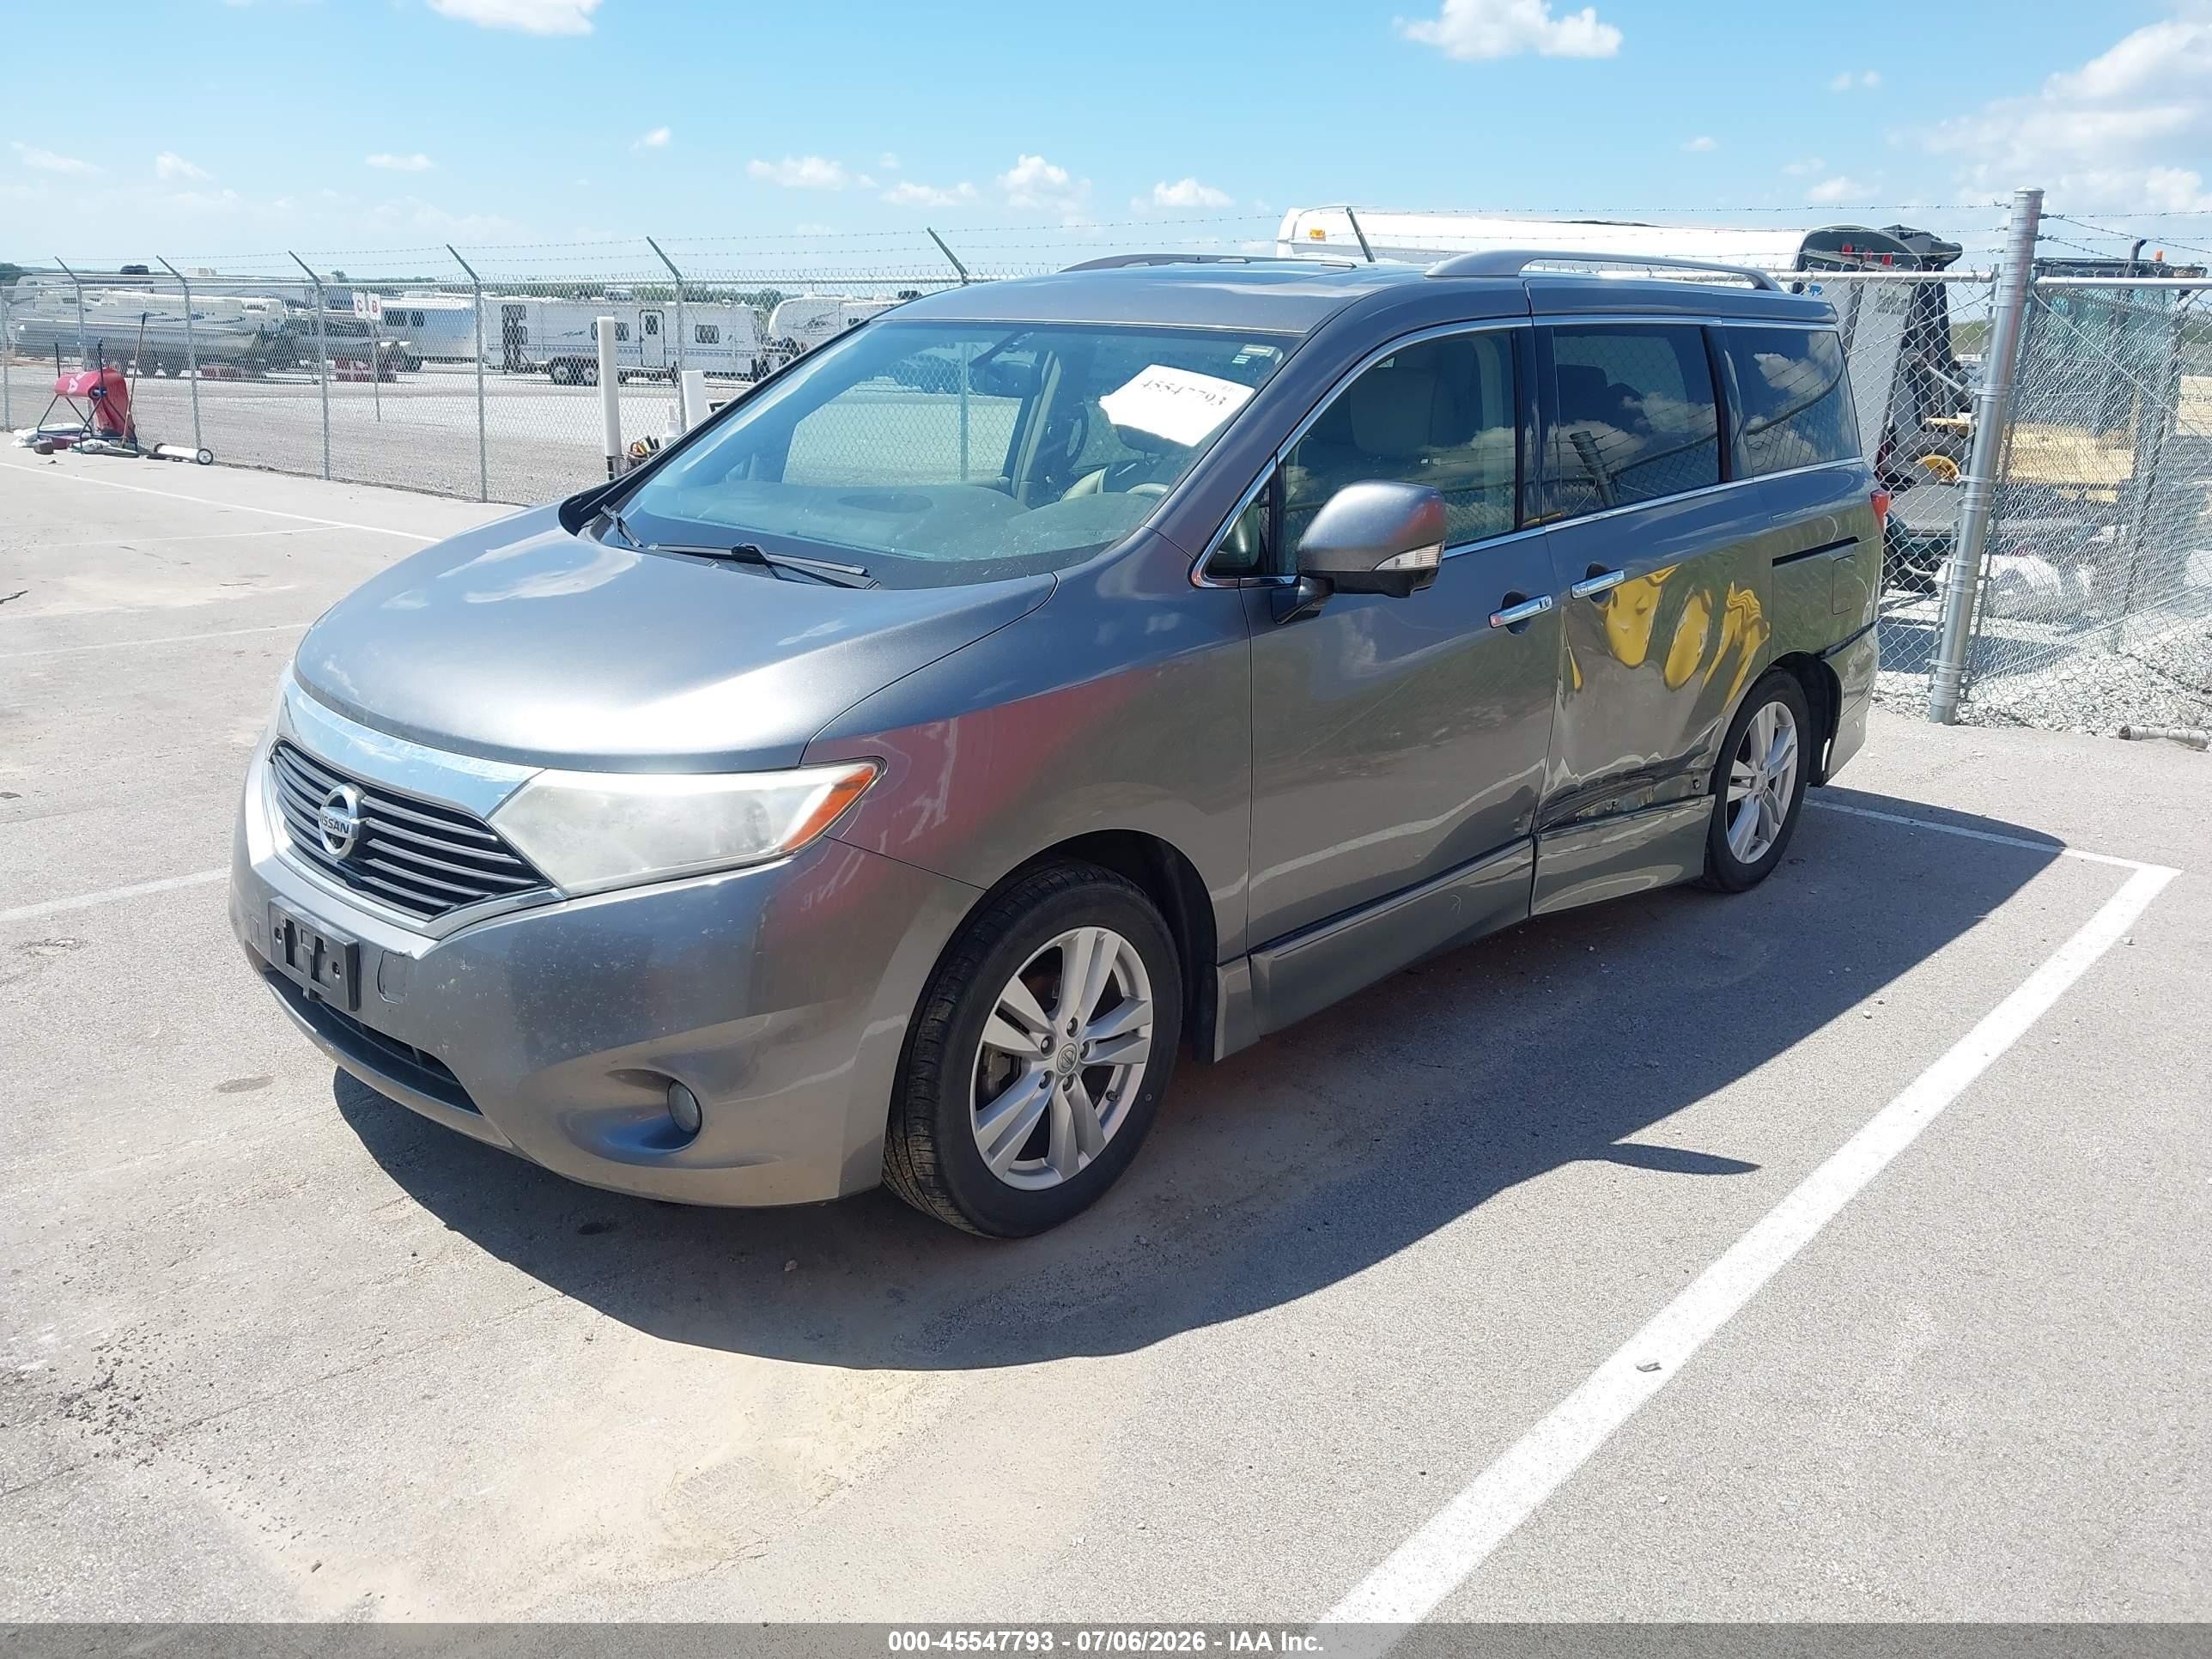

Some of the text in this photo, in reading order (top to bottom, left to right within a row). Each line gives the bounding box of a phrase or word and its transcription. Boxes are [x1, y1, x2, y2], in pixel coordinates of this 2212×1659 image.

[356, 299, 363, 312] C
[372, 300, 379, 313] B
[320, 812, 349, 834] NISSAN
